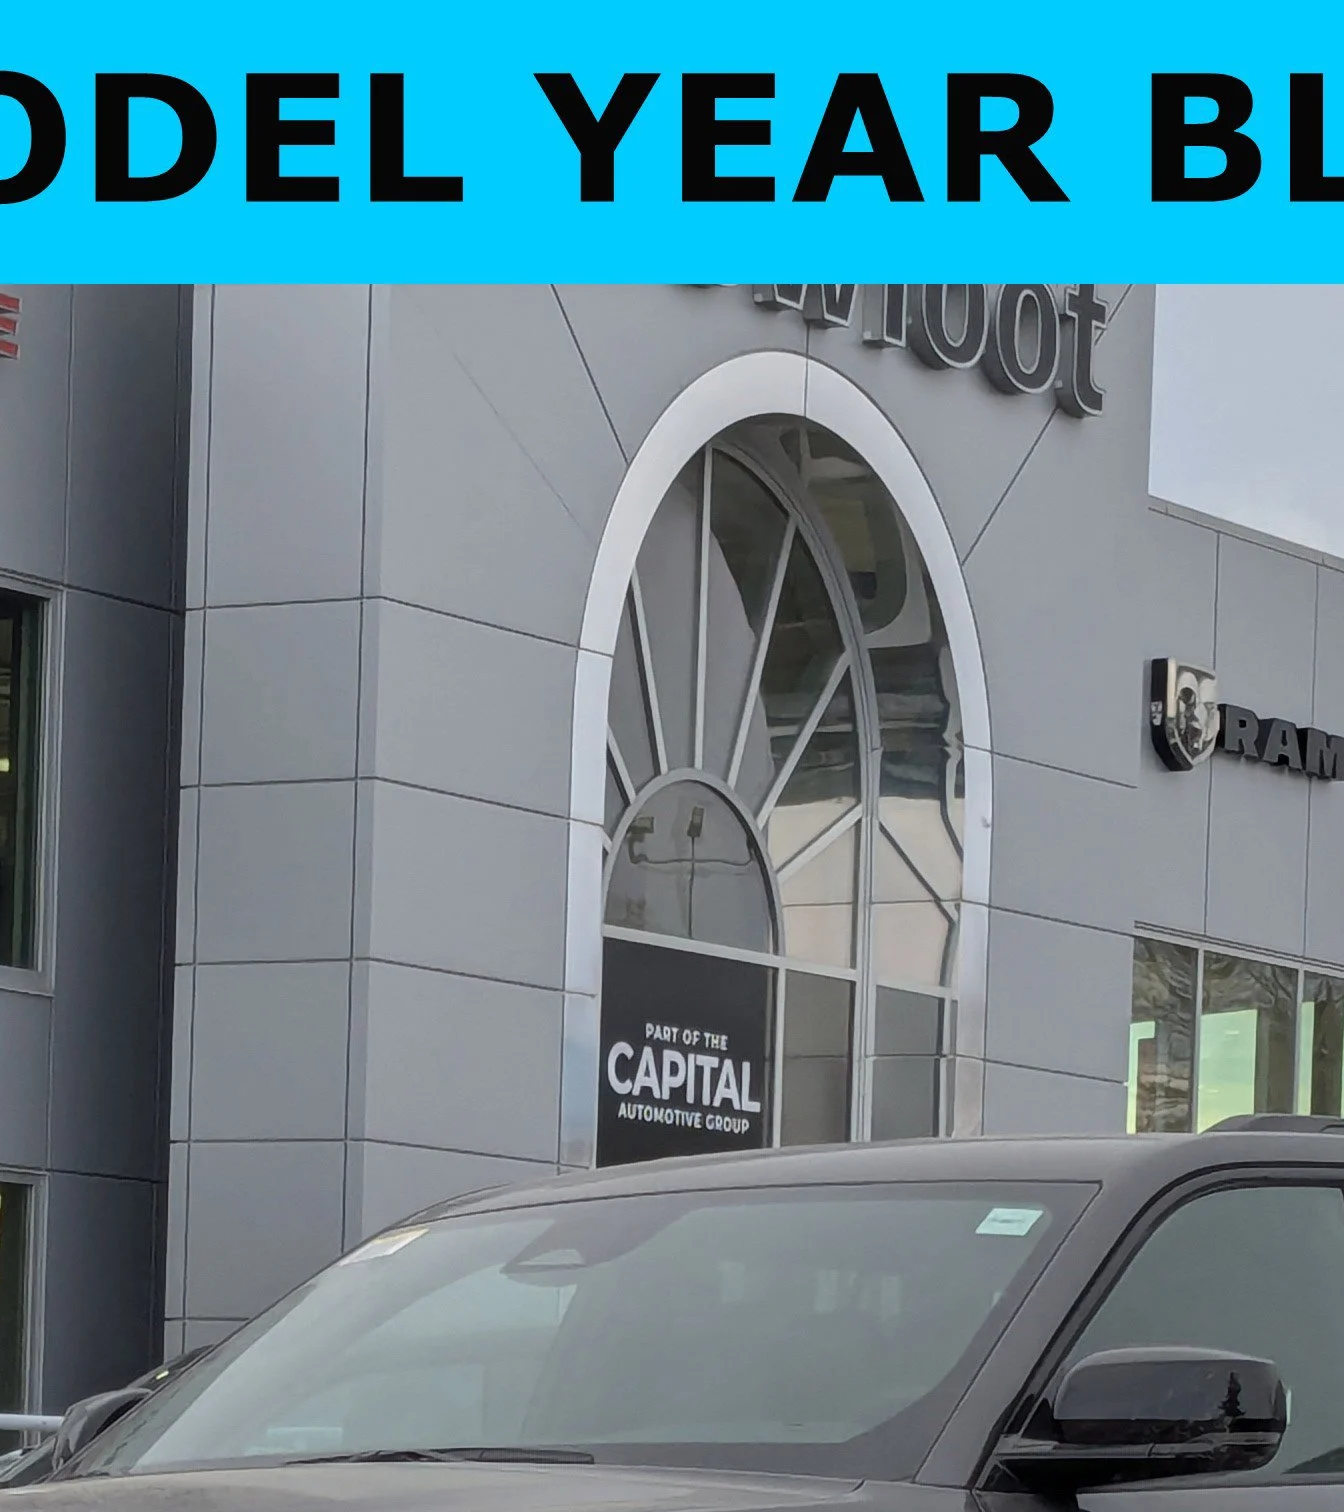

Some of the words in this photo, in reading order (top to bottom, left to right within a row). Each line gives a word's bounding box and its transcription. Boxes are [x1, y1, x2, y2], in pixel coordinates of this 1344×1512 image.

[646, 1023, 677, 1043] PART
[682, 1029, 701, 1046] OF
[705, 1032, 728, 1051] THE
[607, 1041, 761, 1113] CAPITAL
[618, 1102, 702, 1129] AUTOMOTIVE
[706, 1114, 750, 1135] GROUP
